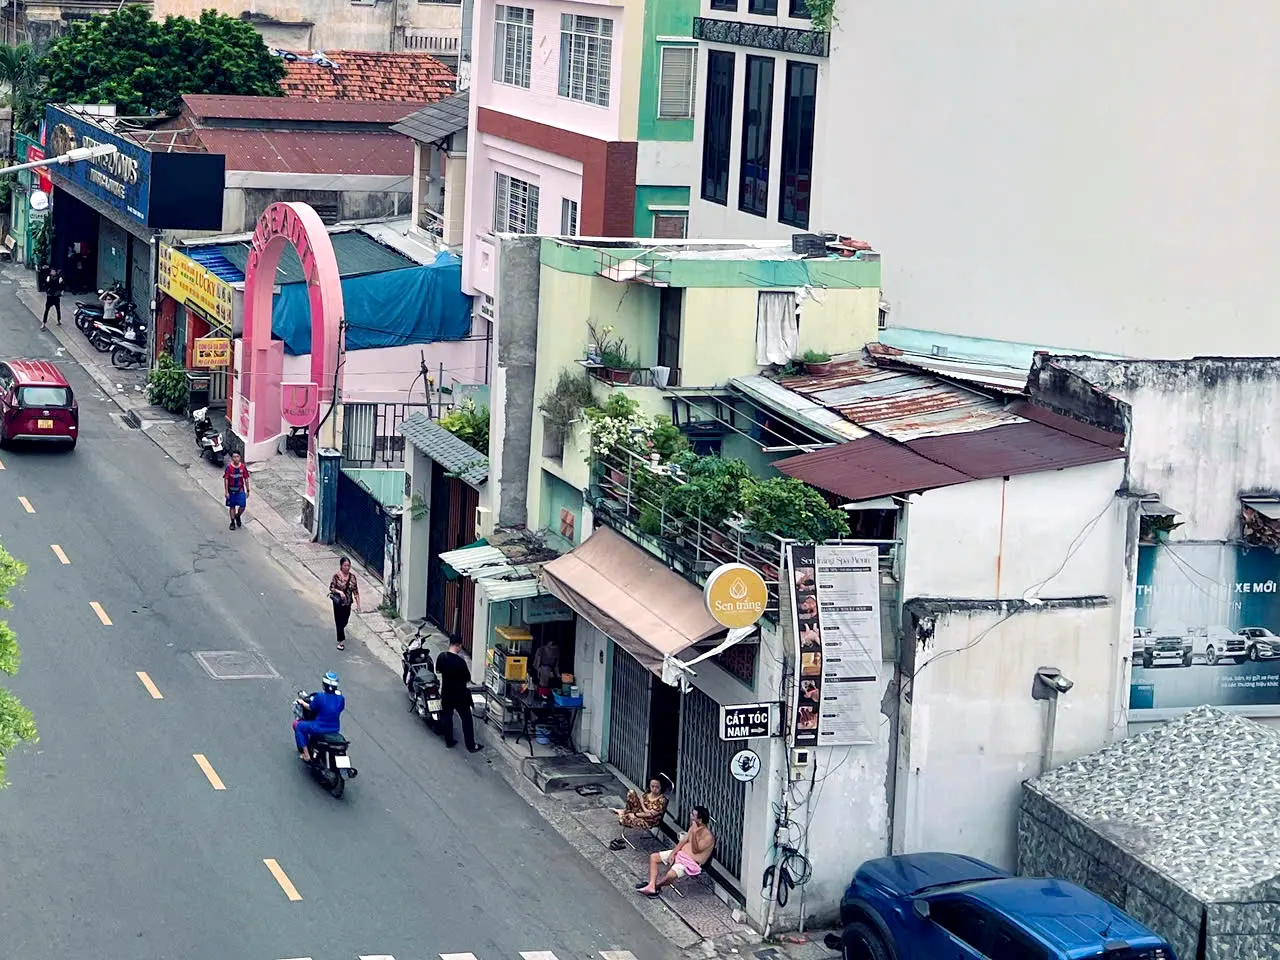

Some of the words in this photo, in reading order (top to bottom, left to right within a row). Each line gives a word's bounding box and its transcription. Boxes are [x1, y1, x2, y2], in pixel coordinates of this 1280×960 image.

[195, 270, 216, 298] LUCKY
[1234, 583, 1251, 593] XE
[1253, 580, 1277, 593] MỚI
[715, 600, 733, 611] Sen
[726, 710, 745, 725] CẮT
[748, 710, 767, 724] TÓC
[727, 726, 749, 737] NAM
